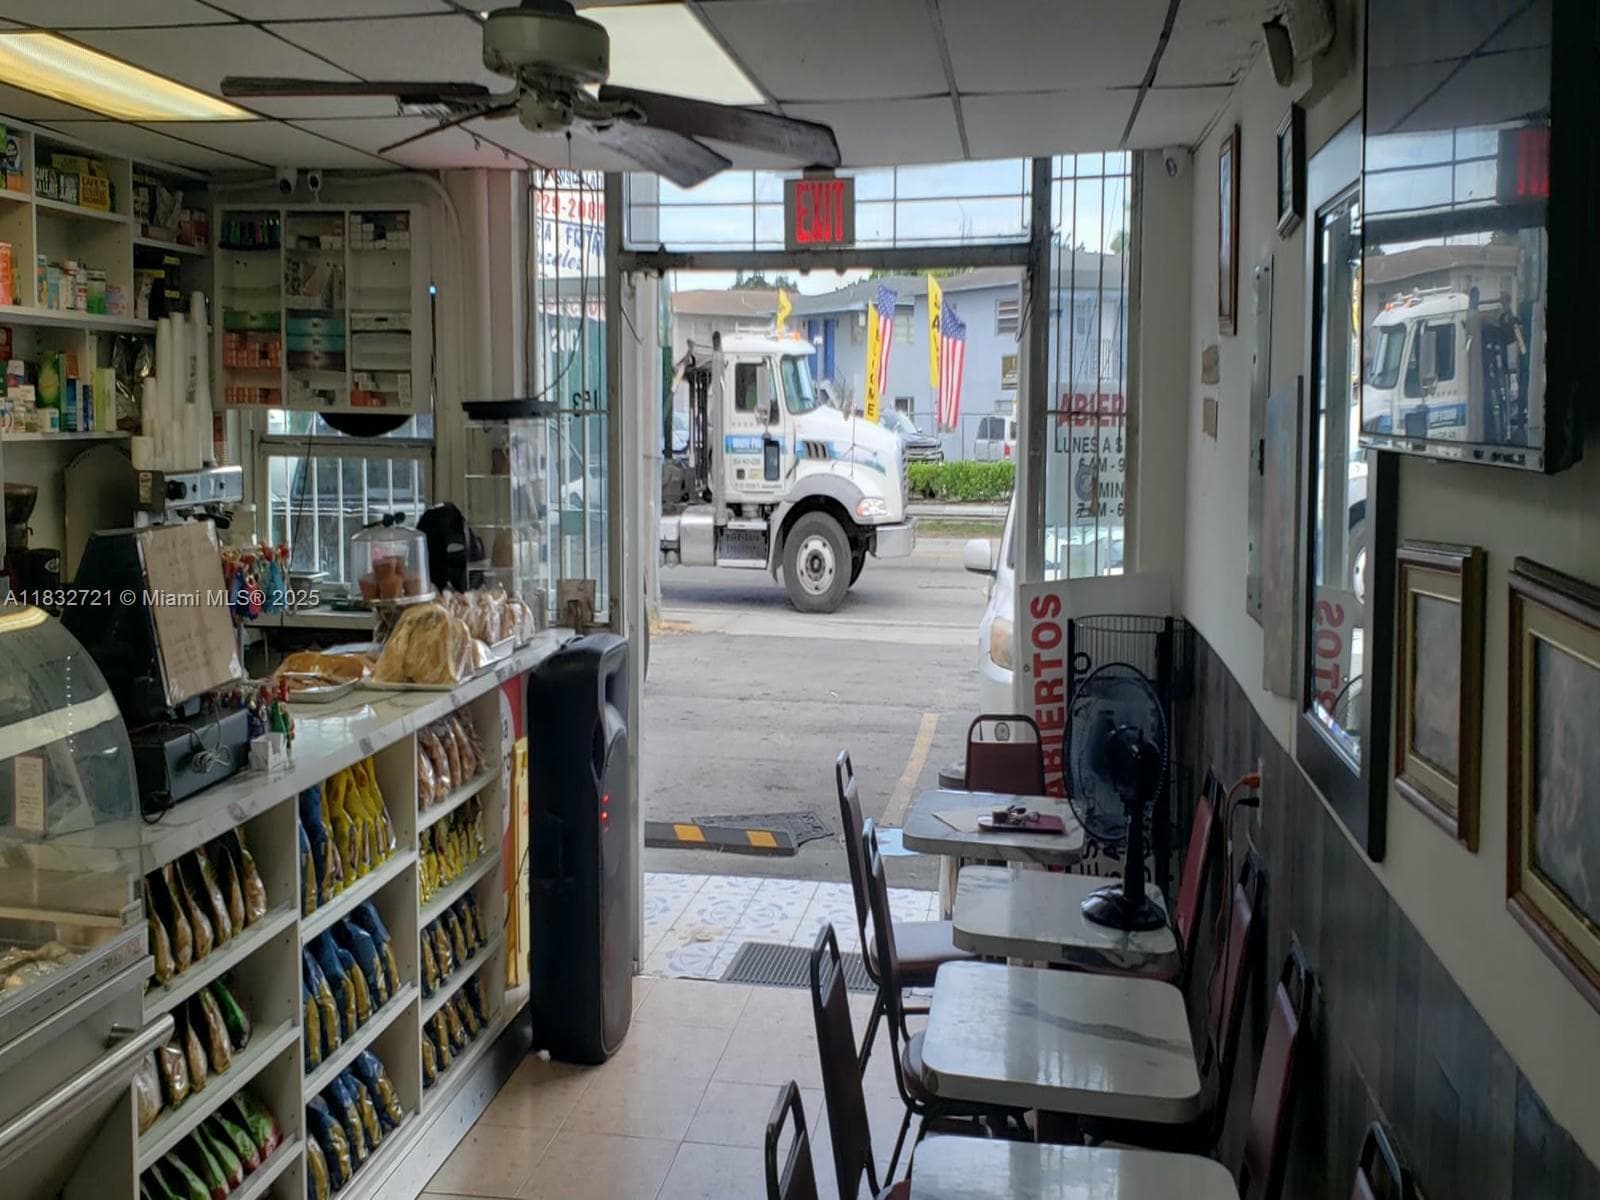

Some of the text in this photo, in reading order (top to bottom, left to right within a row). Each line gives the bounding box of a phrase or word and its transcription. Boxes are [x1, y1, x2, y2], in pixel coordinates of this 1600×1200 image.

[796, 182, 844, 243] EXIT
[1054, 437, 1098, 453] LUNES
[1103, 437, 1111, 453] A
[1030, 593, 1066, 798] ABIERTOS
